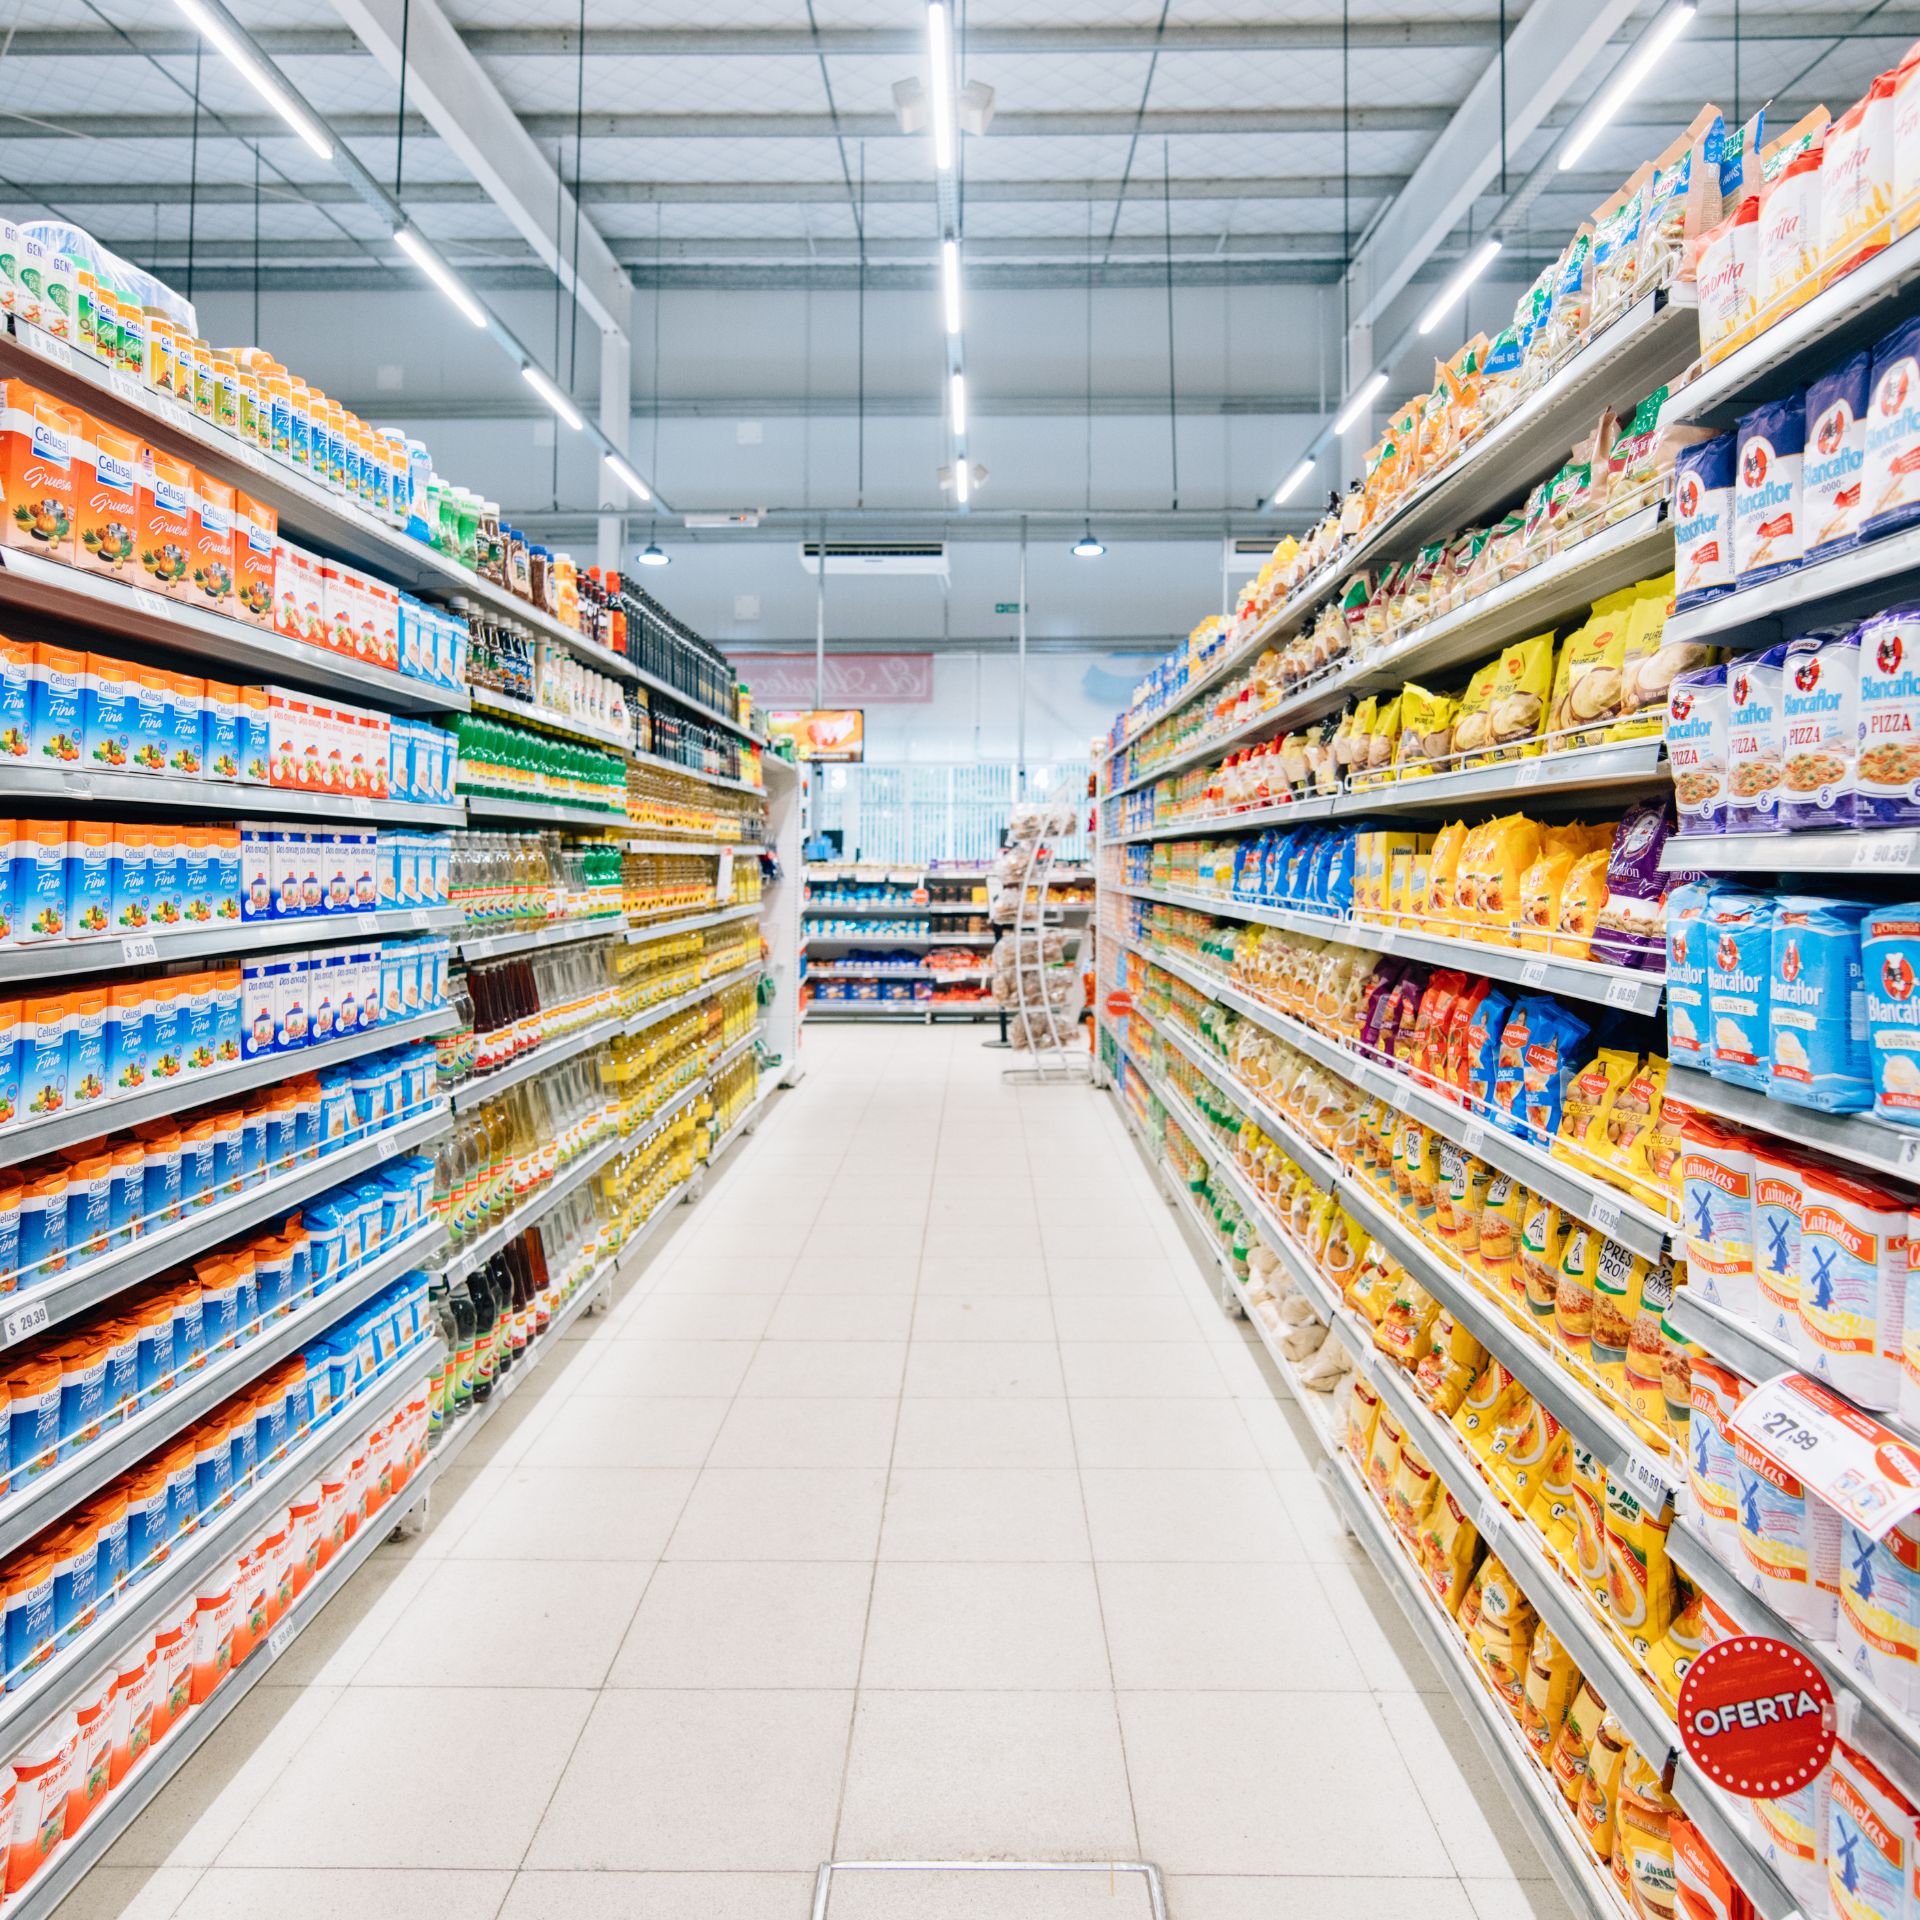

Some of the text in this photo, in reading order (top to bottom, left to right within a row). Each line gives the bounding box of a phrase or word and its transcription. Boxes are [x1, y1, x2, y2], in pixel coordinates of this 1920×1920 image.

[1697, 261, 1744, 300] Favorita
[35, 426, 69, 453] Celusal
[98, 455, 132, 480] Celusal
[23, 466, 72, 492] Gruesa
[156, 481, 186, 503] Celusal
[89, 492, 135, 515] Gruesa
[202, 503, 229, 522] Celusal
[148, 515, 189, 537] Gruesa
[250, 525, 271, 545] Celusal
[197, 535, 231, 556] Gruesa
[244, 555, 272, 575] Gruesa
[50, 673, 77, 688] Celusal
[99, 682, 124, 695] Celusal
[141, 689, 163, 701] Celusal
[175, 697, 197, 709] Celusal
[49, 700, 76, 717] Fina
[98, 707, 124, 723] Fina
[139, 713, 163, 729] Fina
[174, 719, 197, 735] Fina
[1871, 713, 1912, 734] PIZZA
[216, 726, 235, 741] Fina
[250, 731, 266, 745] Fina
[1789, 726, 1821, 745] PIZZA
[1732, 737, 1758, 754] PIZZA
[1671, 750, 1698, 766] PIZZA
[831, 768, 846, 789] 3
[1034, 768, 1048, 789] 4
[1761, 795, 1768, 806] 6
[1822, 789, 1829, 802] 6
[1703, 803, 1710, 814] 6
[39, 848, 60, 858] Celusal
[85, 848, 106, 858] Celusal
[125, 849, 145, 858] Celusal
[153, 849, 174, 858] Celusal
[1858, 849, 1866, 862] $
[37, 872, 60, 892] Fina
[84, 872, 106, 890] Fina
[124, 872, 144, 889] Fina
[154, 870, 176, 887] Fina
[187, 870, 207, 886] Fina
[220, 870, 237, 885] Fina
[126, 944, 155, 959] $ 32.49
[217, 991, 237, 1003] Celusal
[1610, 987, 1616, 998] $
[155, 1000, 177, 1014] Celusal
[190, 996, 210, 1008] Celusal
[1714, 1001, 1749, 1014] LEUDANTE
[80, 1016, 101, 1029] Celusal
[122, 1008, 142, 1021] Celusal
[217, 1013, 236, 1030] Fina
[37, 1024, 62, 1038] Celusal
[156, 1024, 177, 1042] Fina
[191, 1017, 210, 1035] Fina
[122, 1032, 142, 1051] Fina
[79, 1041, 100, 1062] Fina
[35, 1052, 61, 1073] Fina
[1569, 1102, 1593, 1113] chipa
[1617, 1111, 1643, 1123] chipa
[1908, 1144, 1917, 1163] $
[196, 1157, 213, 1177] Fina
[1683, 1154, 1736, 1190] Cañuelas
[90, 1178, 110, 1191] Celusal
[47, 1193, 67, 1208] Celusal
[125, 1187, 143, 1204] Fina
[0, 1212, 19, 1224] elusal
[87, 1198, 108, 1220] Fina
[1592, 1205, 1598, 1217] $
[44, 1217, 66, 1239] Fina
[1803, 1211, 1862, 1252] Cañuelas
[1724, 1263, 1738, 1274] 000
[9, 1306, 46, 1336] $ 29.39
[185, 1321, 201, 1342] Fina
[116, 1340, 137, 1358] Celusal
[154, 1343, 172, 1364] Fina
[1841, 1339, 1856, 1351] 000
[84, 1363, 104, 1381] Celusal
[113, 1365, 136, 1386] Fina
[40, 1385, 61, 1406] Celusal
[80, 1389, 102, 1411] Fina
[1691, 1388, 1727, 1435] Cañuelas
[36, 1413, 59, 1438] Fina
[215, 1462, 230, 1482] Fina
[1630, 1458, 1660, 1493] $ 60.59
[175, 1487, 194, 1505] Fina
[146, 1512, 167, 1537] Fina
[73, 1549, 97, 1568] Celusal
[110, 1542, 127, 1564] Fina
[1620, 1544, 1646, 1583] Polenta
[1774, 1567, 1791, 1578] 000
[27, 1579, 53, 1602] Celusal
[73, 1572, 95, 1598] Fina
[27, 1605, 52, 1637] Fina
[1879, 1637, 1896, 1653] 000
[1694, 1689, 1821, 1737] OFERTA
